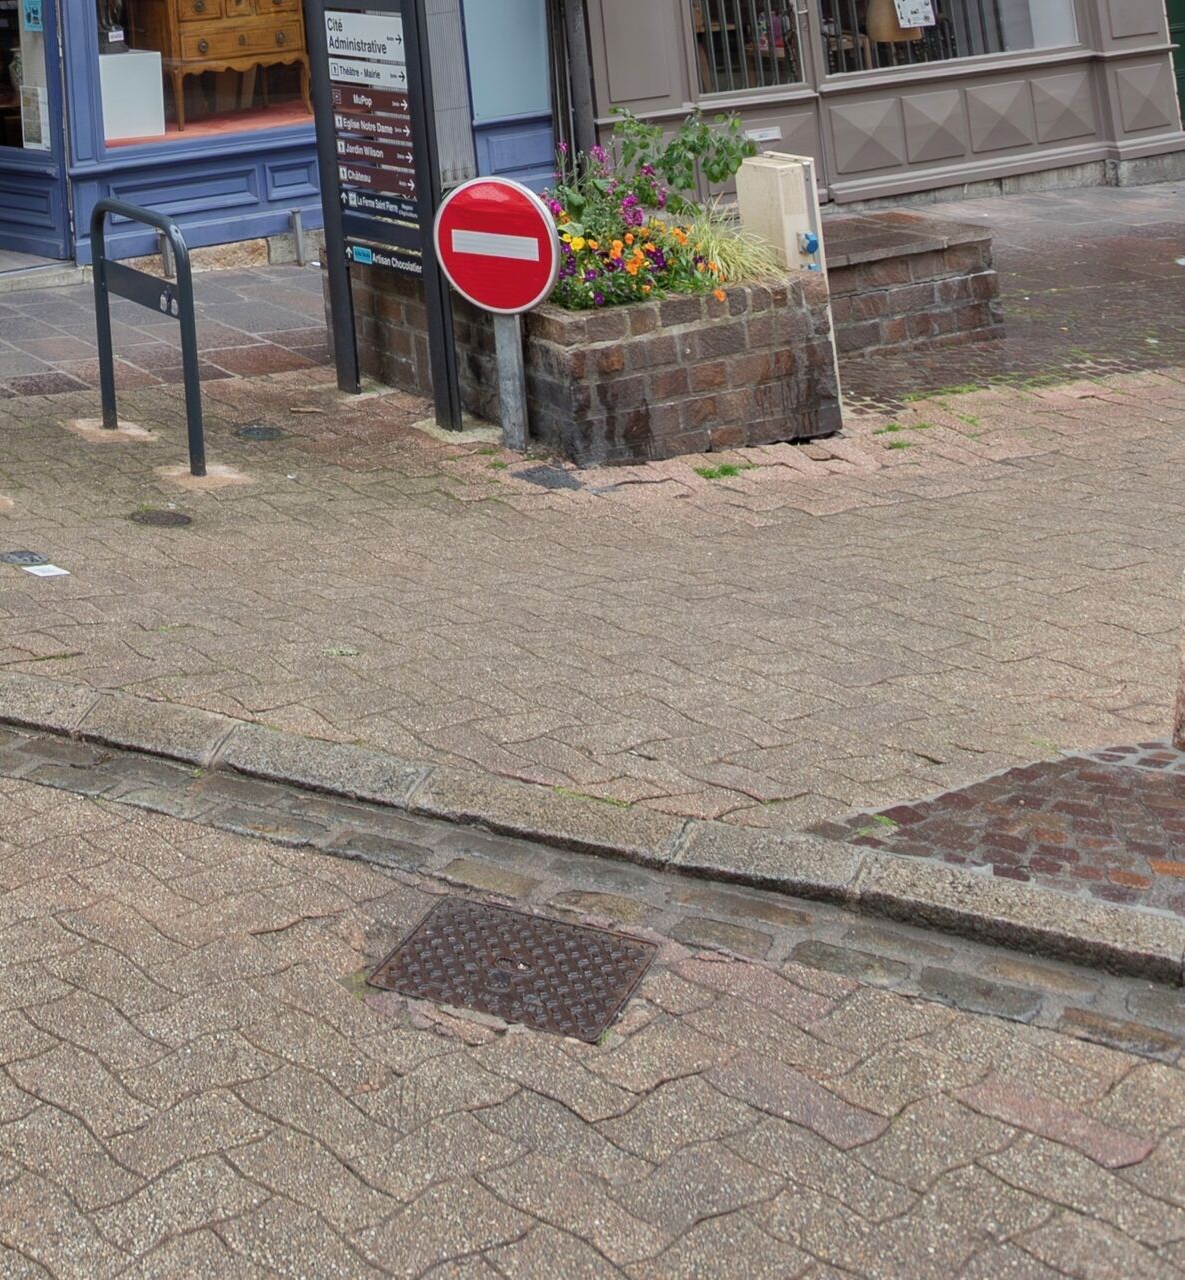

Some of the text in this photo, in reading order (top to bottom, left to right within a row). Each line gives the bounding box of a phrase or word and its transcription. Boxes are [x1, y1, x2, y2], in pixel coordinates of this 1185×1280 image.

[327, 17, 343, 32] Cité
[329, 35, 387, 54] Administrative
[339, 65, 359, 77] Théâtre
[363, 68, 381, 79] Mairie
[360, 120, 376, 132] Notre
[376, 122, 393, 134] Dame
[345, 143, 364, 155] Jardin
[364, 145, 384, 158] Wilson
[347, 169, 371, 183] Château
[372, 252, 391, 267] Artisan
[391, 256, 422, 273] Chocolatier
